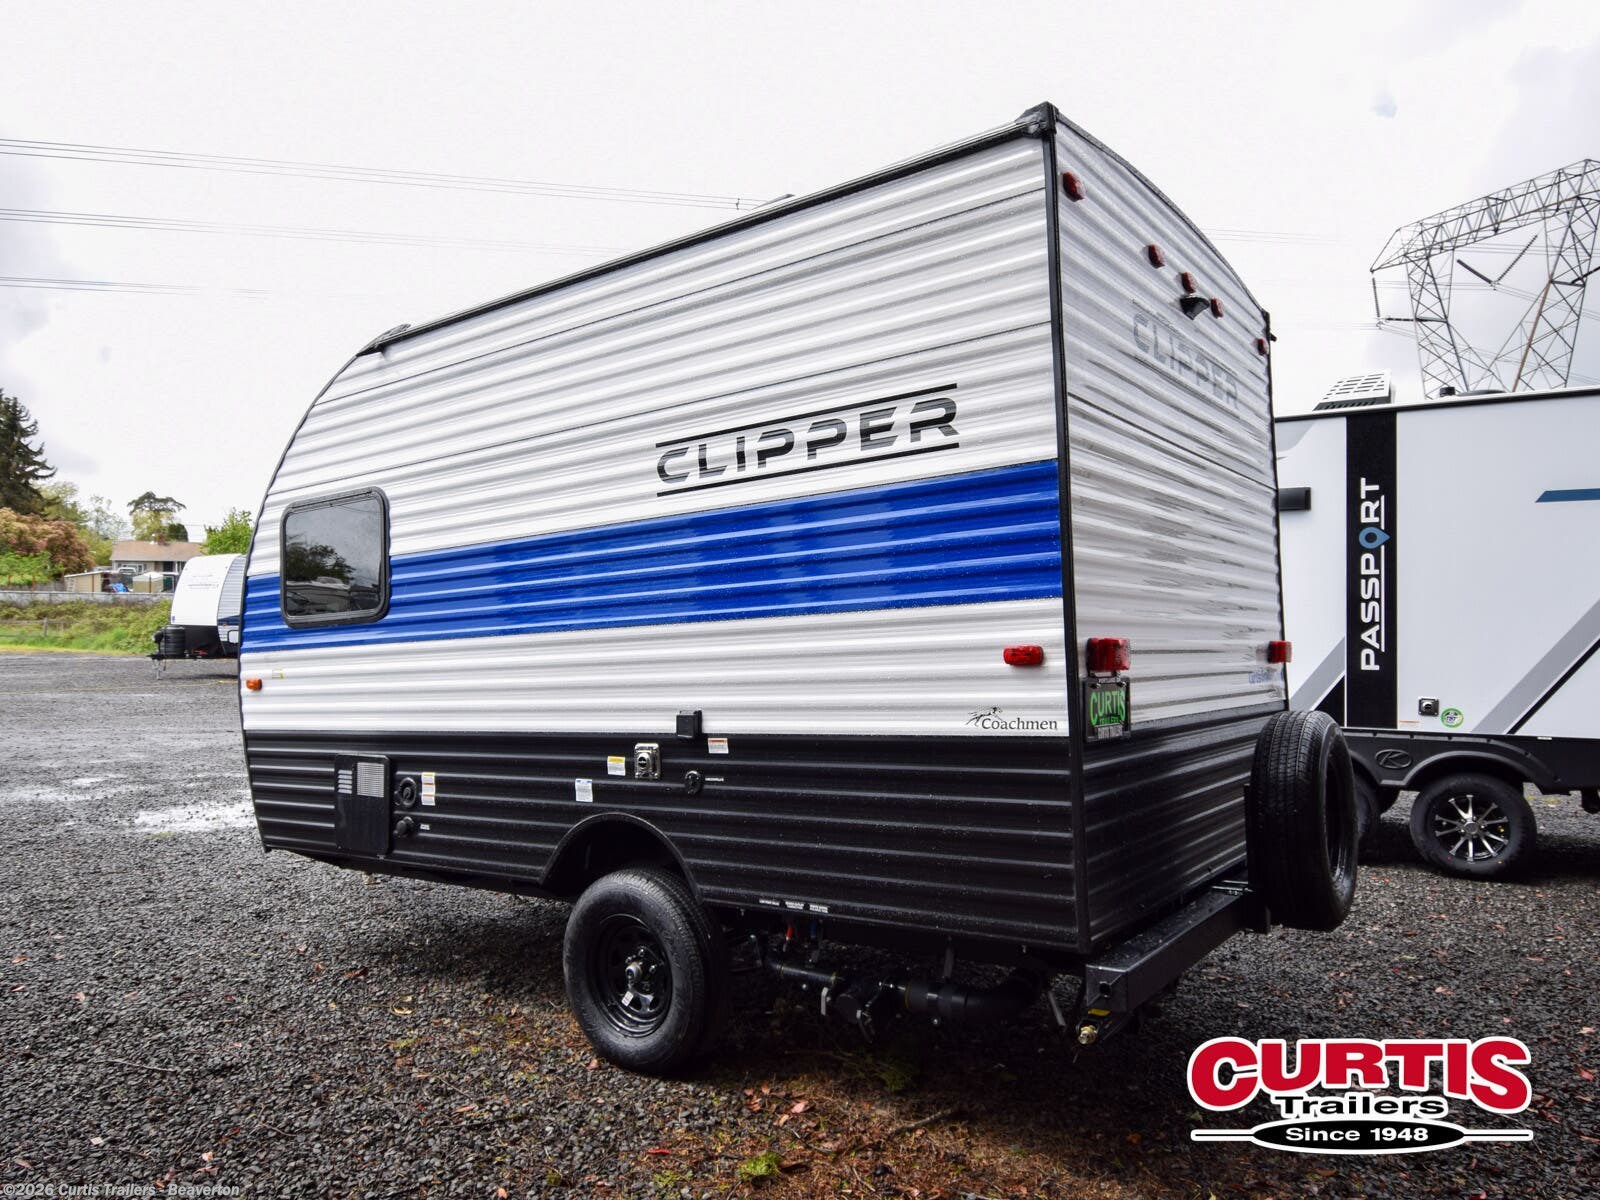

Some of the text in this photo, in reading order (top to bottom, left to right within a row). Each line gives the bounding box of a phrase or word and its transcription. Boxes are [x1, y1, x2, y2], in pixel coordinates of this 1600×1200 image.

[1133, 312, 1239, 409] CLIPPER
[656, 397, 960, 485] CLIPPER
[981, 717, 1058, 730] Coachmen
[1089, 691, 1126, 726] CURTIS
